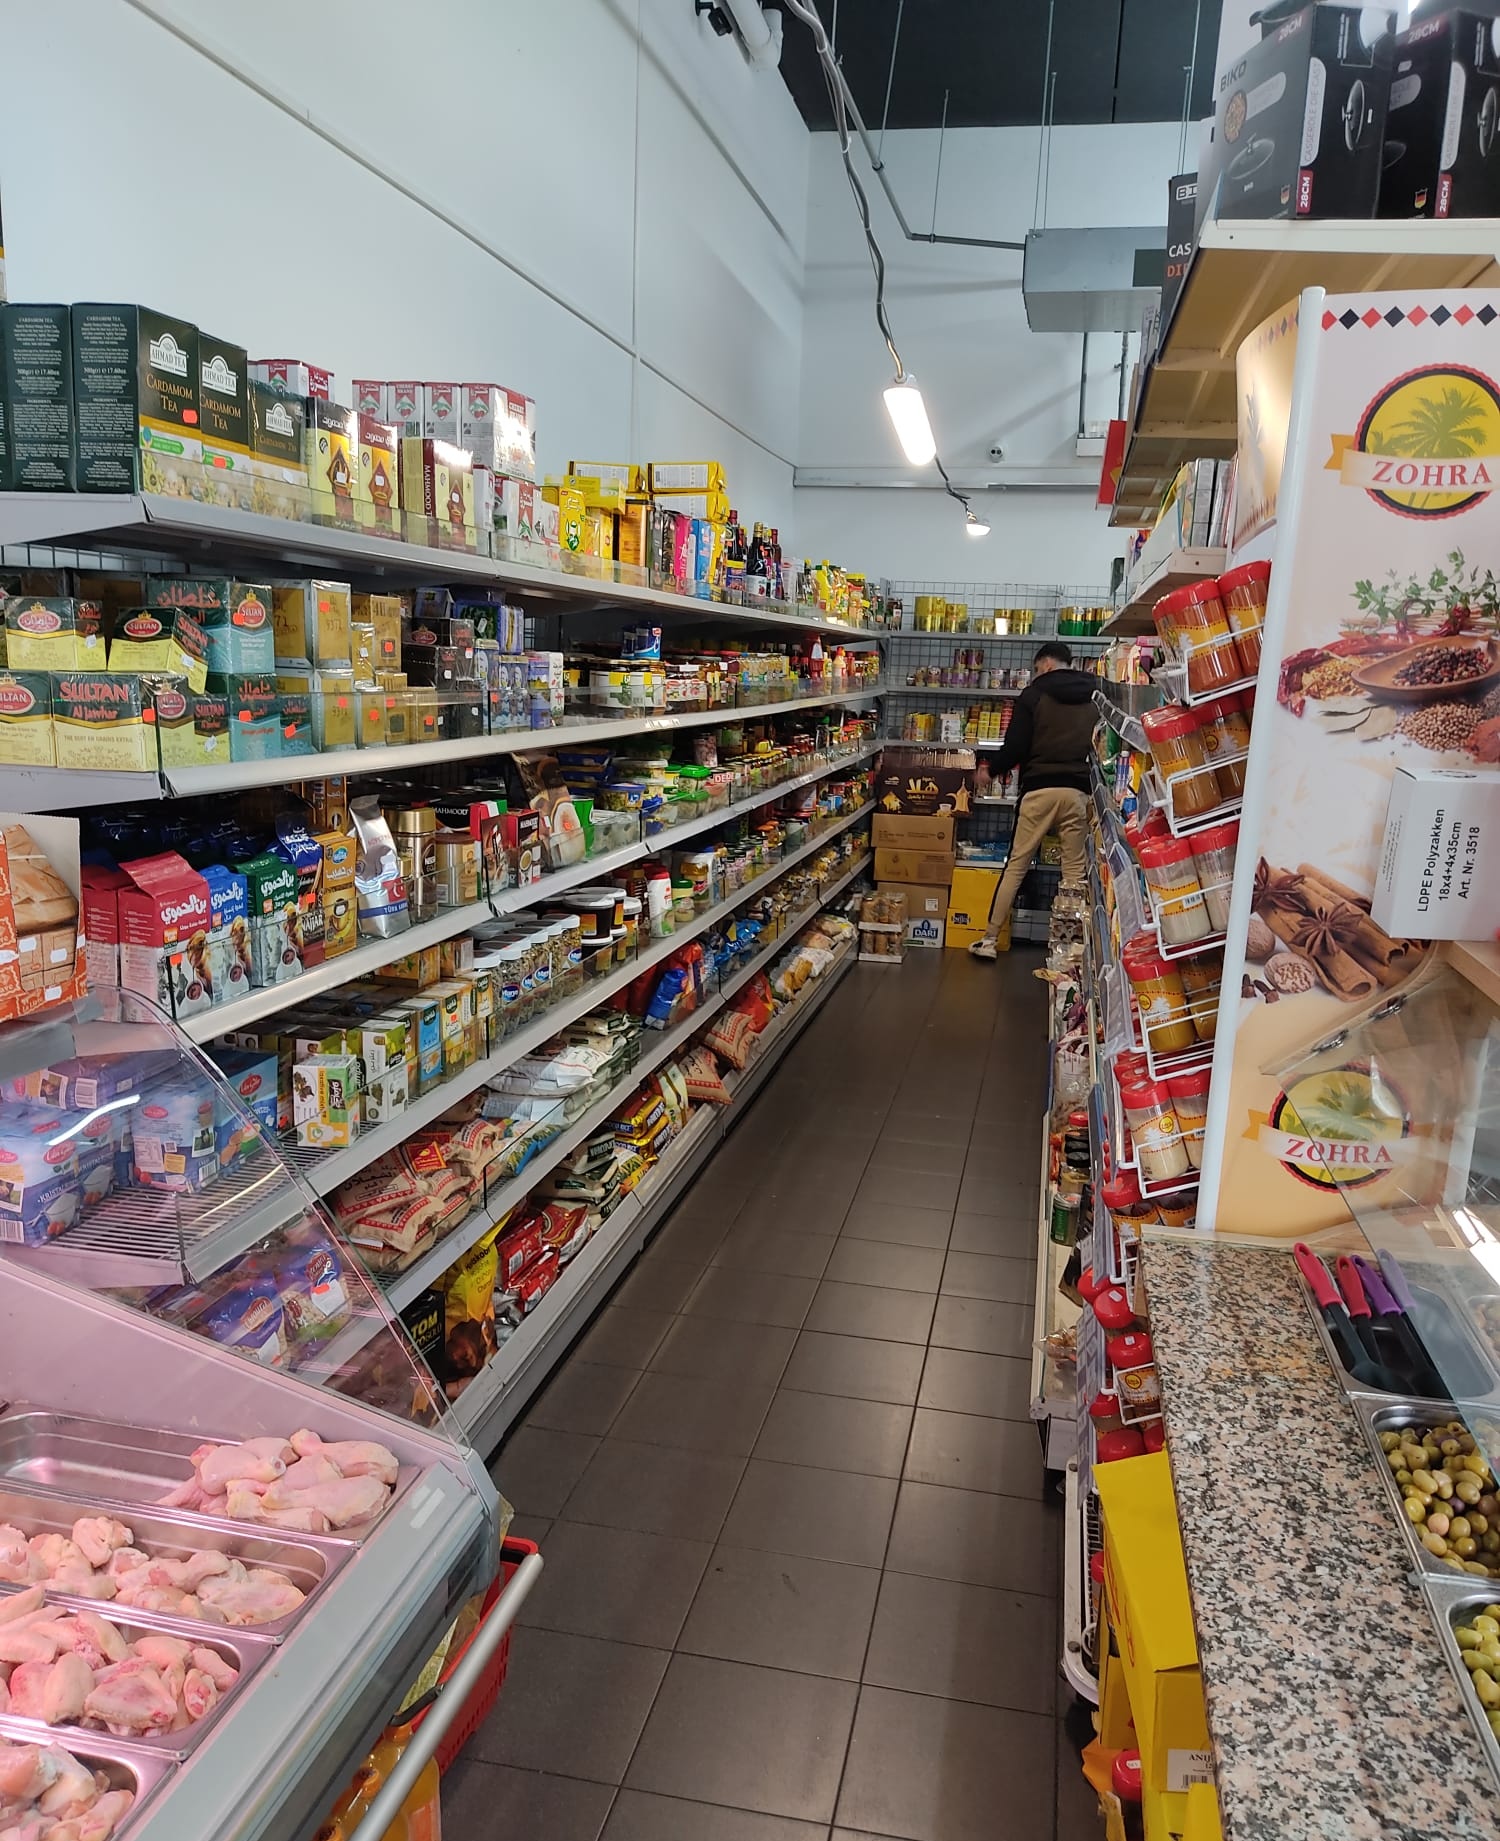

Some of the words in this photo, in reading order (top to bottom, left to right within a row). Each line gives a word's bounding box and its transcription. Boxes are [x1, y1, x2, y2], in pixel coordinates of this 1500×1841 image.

[1407, 21, 1440, 44] 28CM
[1220, 60, 1247, 93] BIKO
[1300, 176, 1311, 208] 28CM
[1440, 181, 1450, 212] 28CM
[151, 348, 174, 364] AHMAD
[174, 354, 186, 369] TEA
[146, 374, 193, 399] CARDAMOM
[203, 369, 224, 385] AHMAD
[225, 375, 236, 388] TEA
[160, 395, 178, 413] TEA
[200, 394, 241, 418] CARDAMOM
[213, 413, 228, 431] TEA
[1372, 460, 1492, 486] ZOHRA
[424, 464, 432, 511] MAHMOOD
[241, 607, 262, 617] SULTAN
[130, 622, 157, 631] SULTAN
[59, 681, 129, 702] SULTAN
[1424, 809, 1445, 876] Polyzakken
[1466, 826, 1480, 855] 3518
[1438, 822, 1462, 901] 18x4+4x35cm
[1462, 858, 1475, 874] Nr.
[1417, 880, 1433, 912] LDPE
[1458, 879, 1471, 899] Art.
[914, 929, 936, 937] DARI
[1286, 1138, 1393, 1163] ZOHRA
[411, 1310, 438, 1337] TOM
